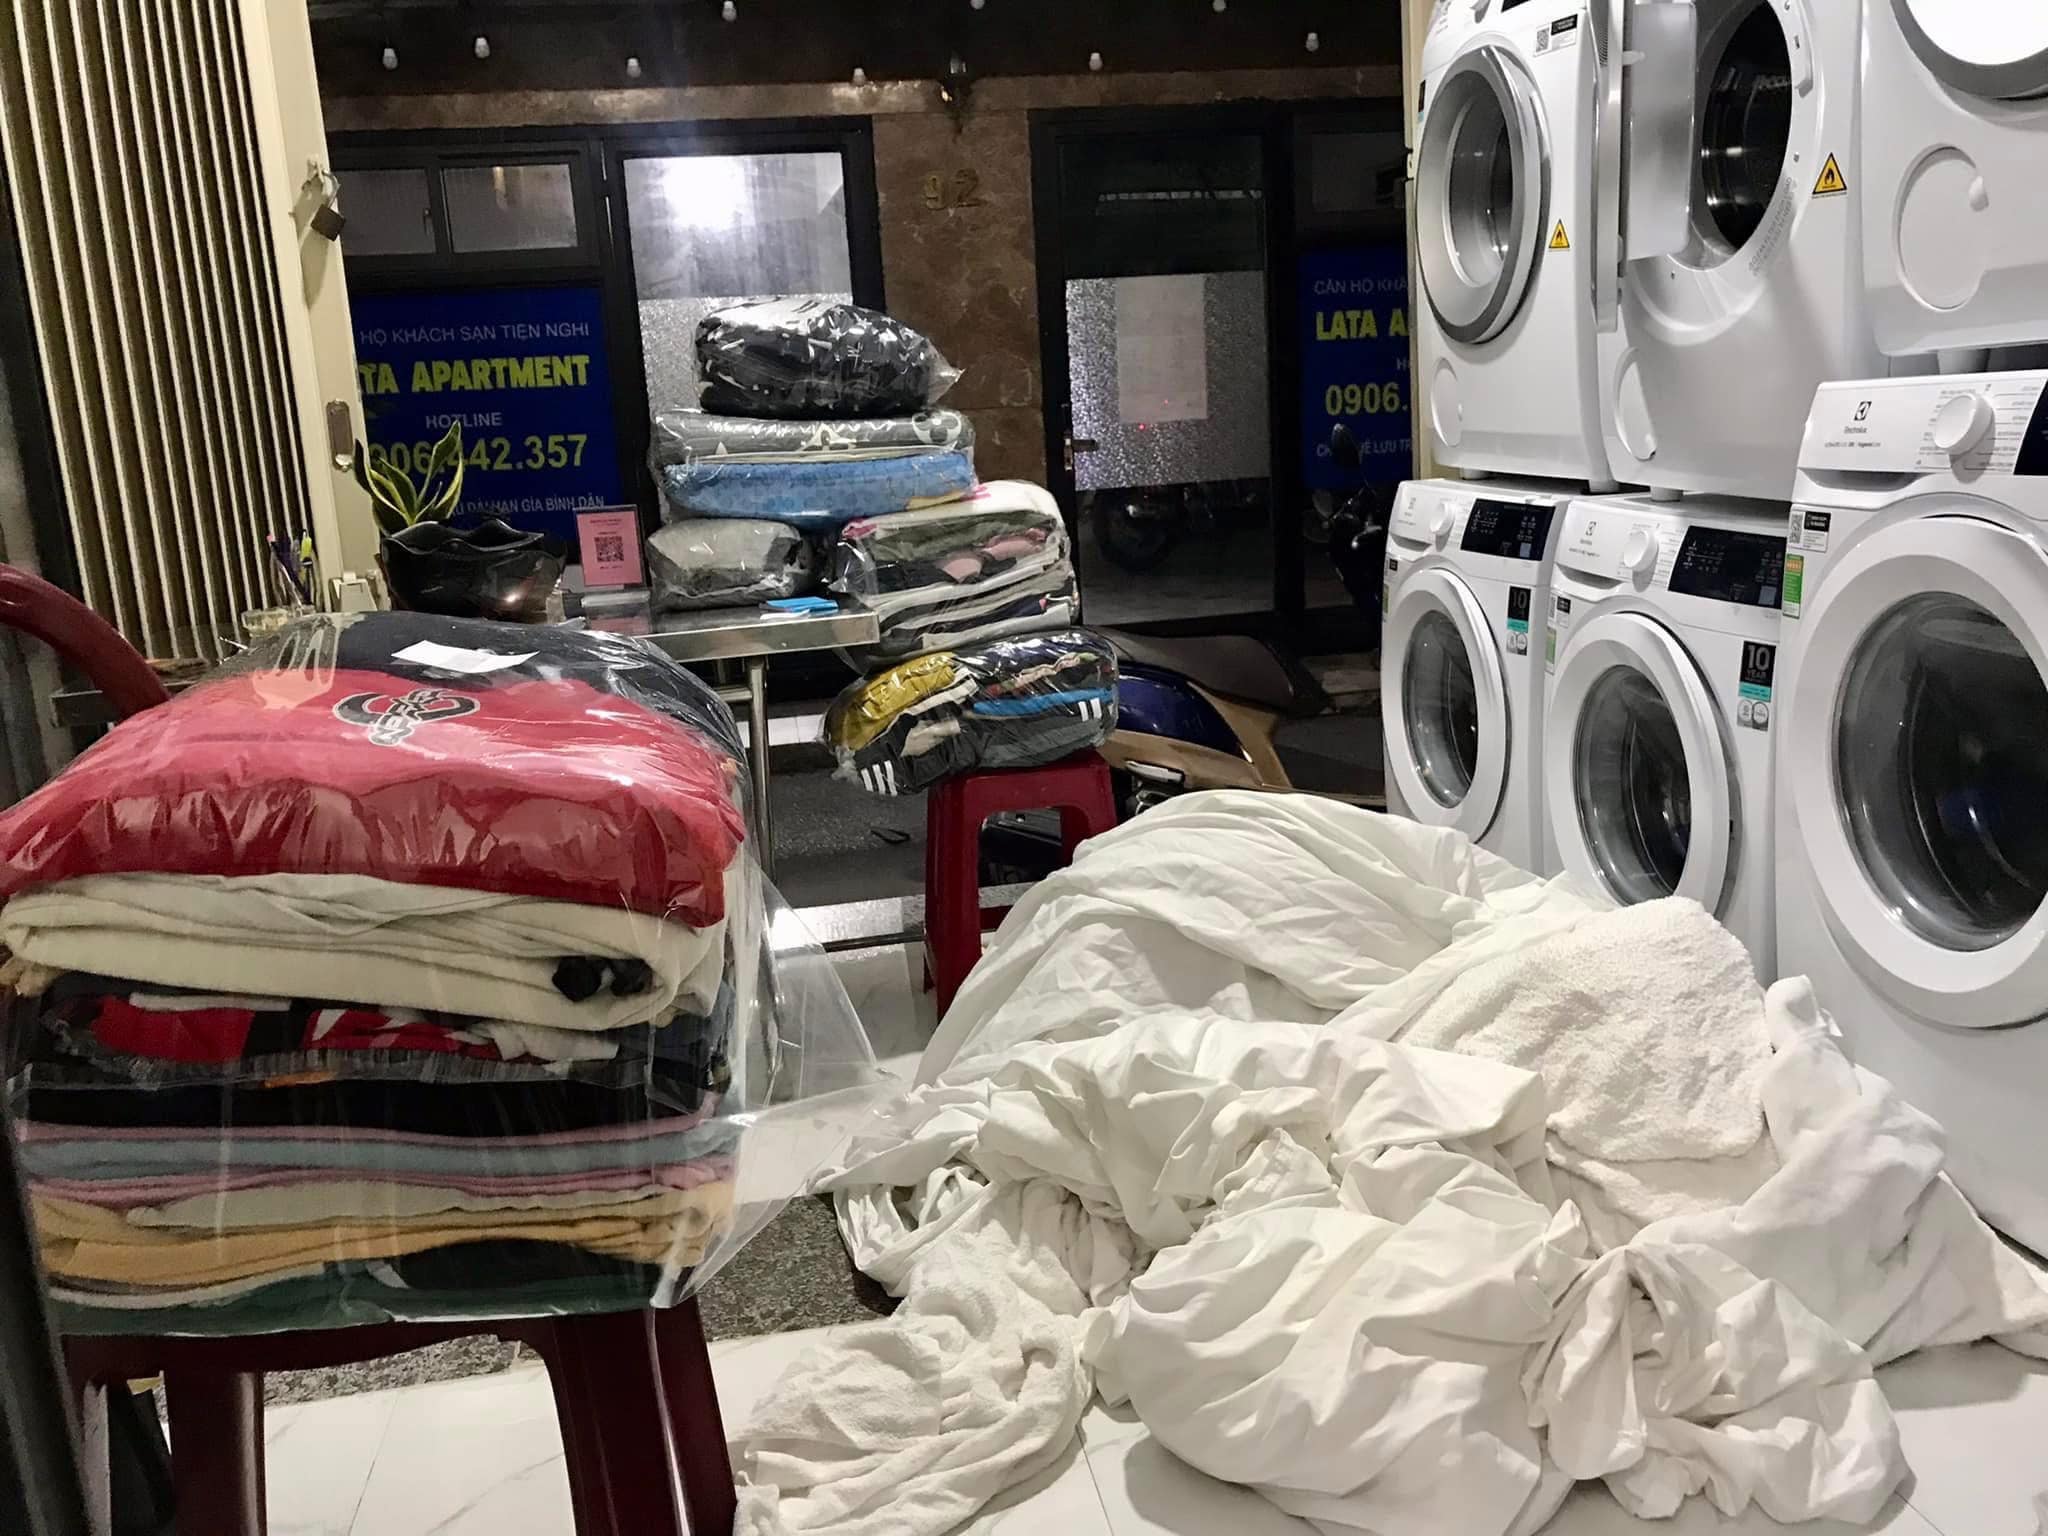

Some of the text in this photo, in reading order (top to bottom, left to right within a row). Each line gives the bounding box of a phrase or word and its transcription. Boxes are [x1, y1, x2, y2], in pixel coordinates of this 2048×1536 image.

[545, 322, 590, 338] NGHI
[1316, 308, 1378, 341] LATA
[411, 355, 591, 393] APARTMENT
[1747, 644, 1770, 671] 10
